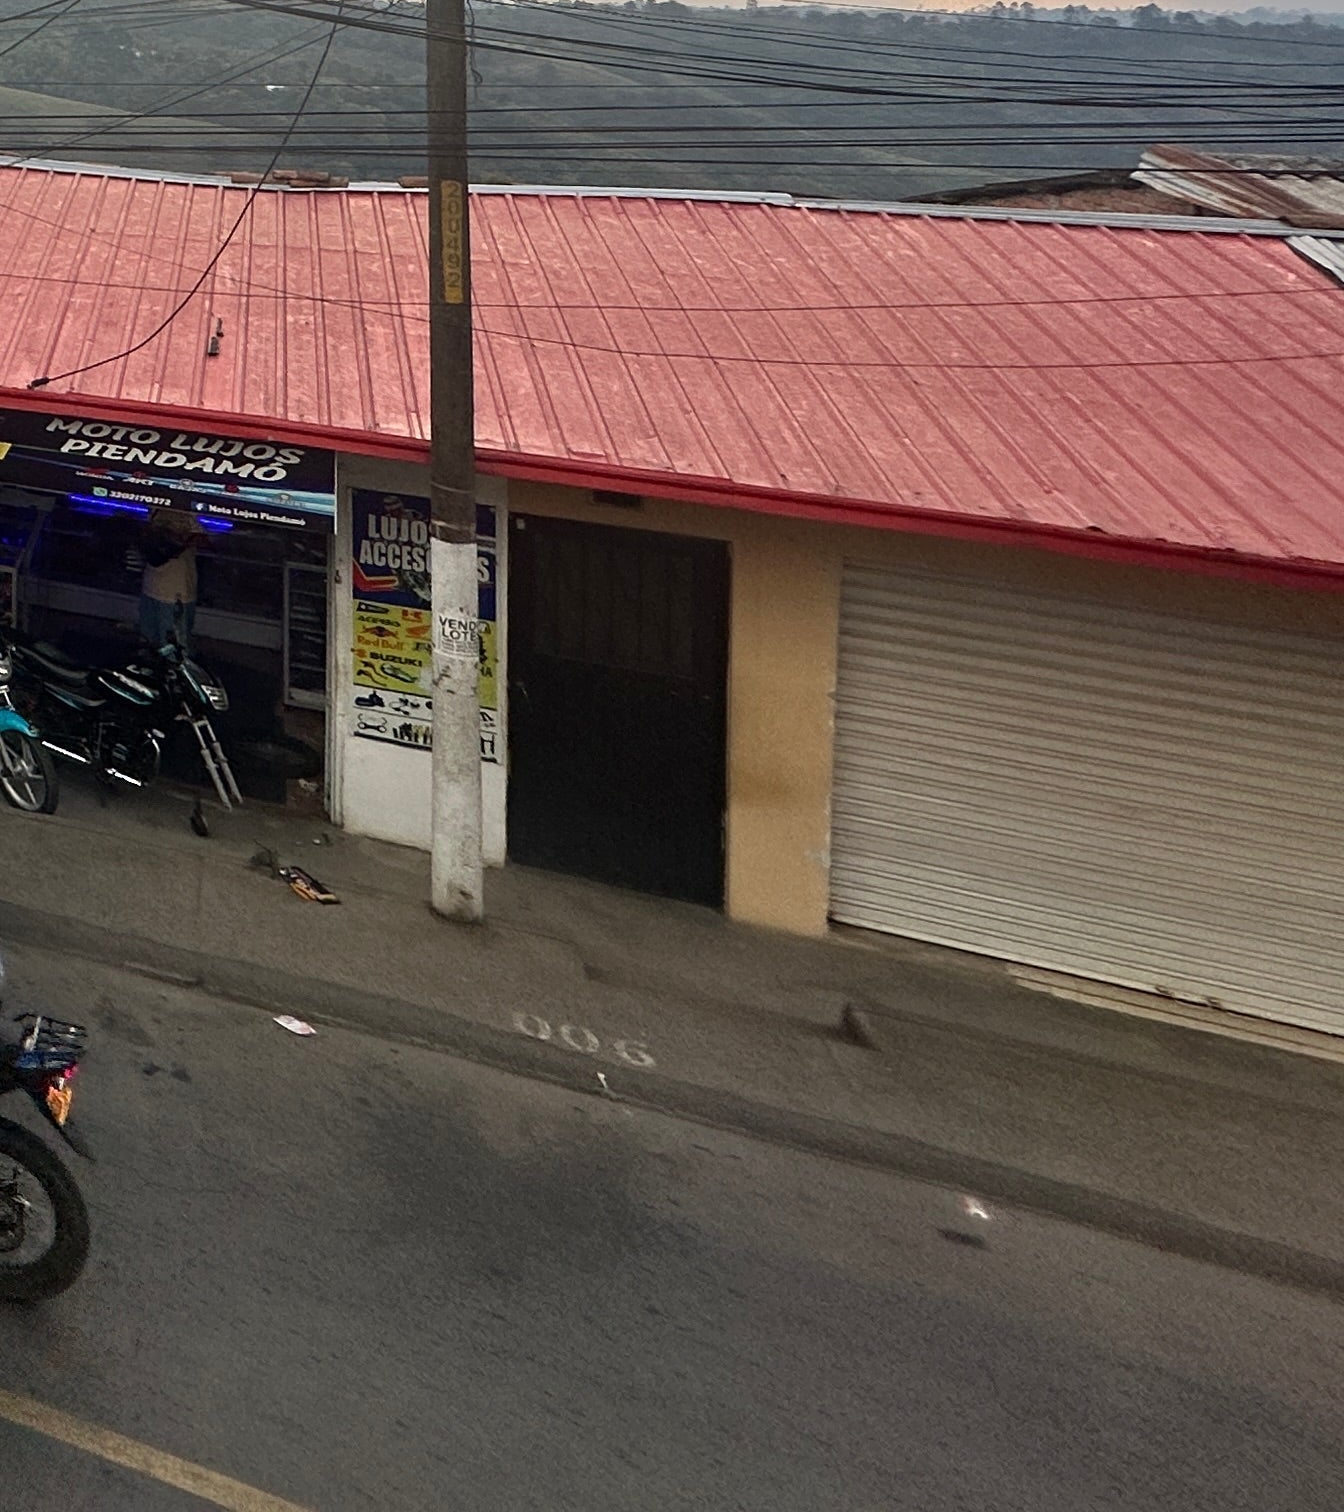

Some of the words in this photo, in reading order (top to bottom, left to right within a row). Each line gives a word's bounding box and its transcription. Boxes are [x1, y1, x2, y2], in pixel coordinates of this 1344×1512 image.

[46, 418, 161, 445] MOTO
[170, 434, 305, 465] LUJOS
[60, 438, 288, 482] PIENDAMÓ
[208, 504, 232, 515] Moto
[233, 508, 259, 520] Lujos
[367, 513, 432, 546] LUJO
[359, 539, 491, 584] ACCESS
[369, 651, 423, 668] SUZUKI
